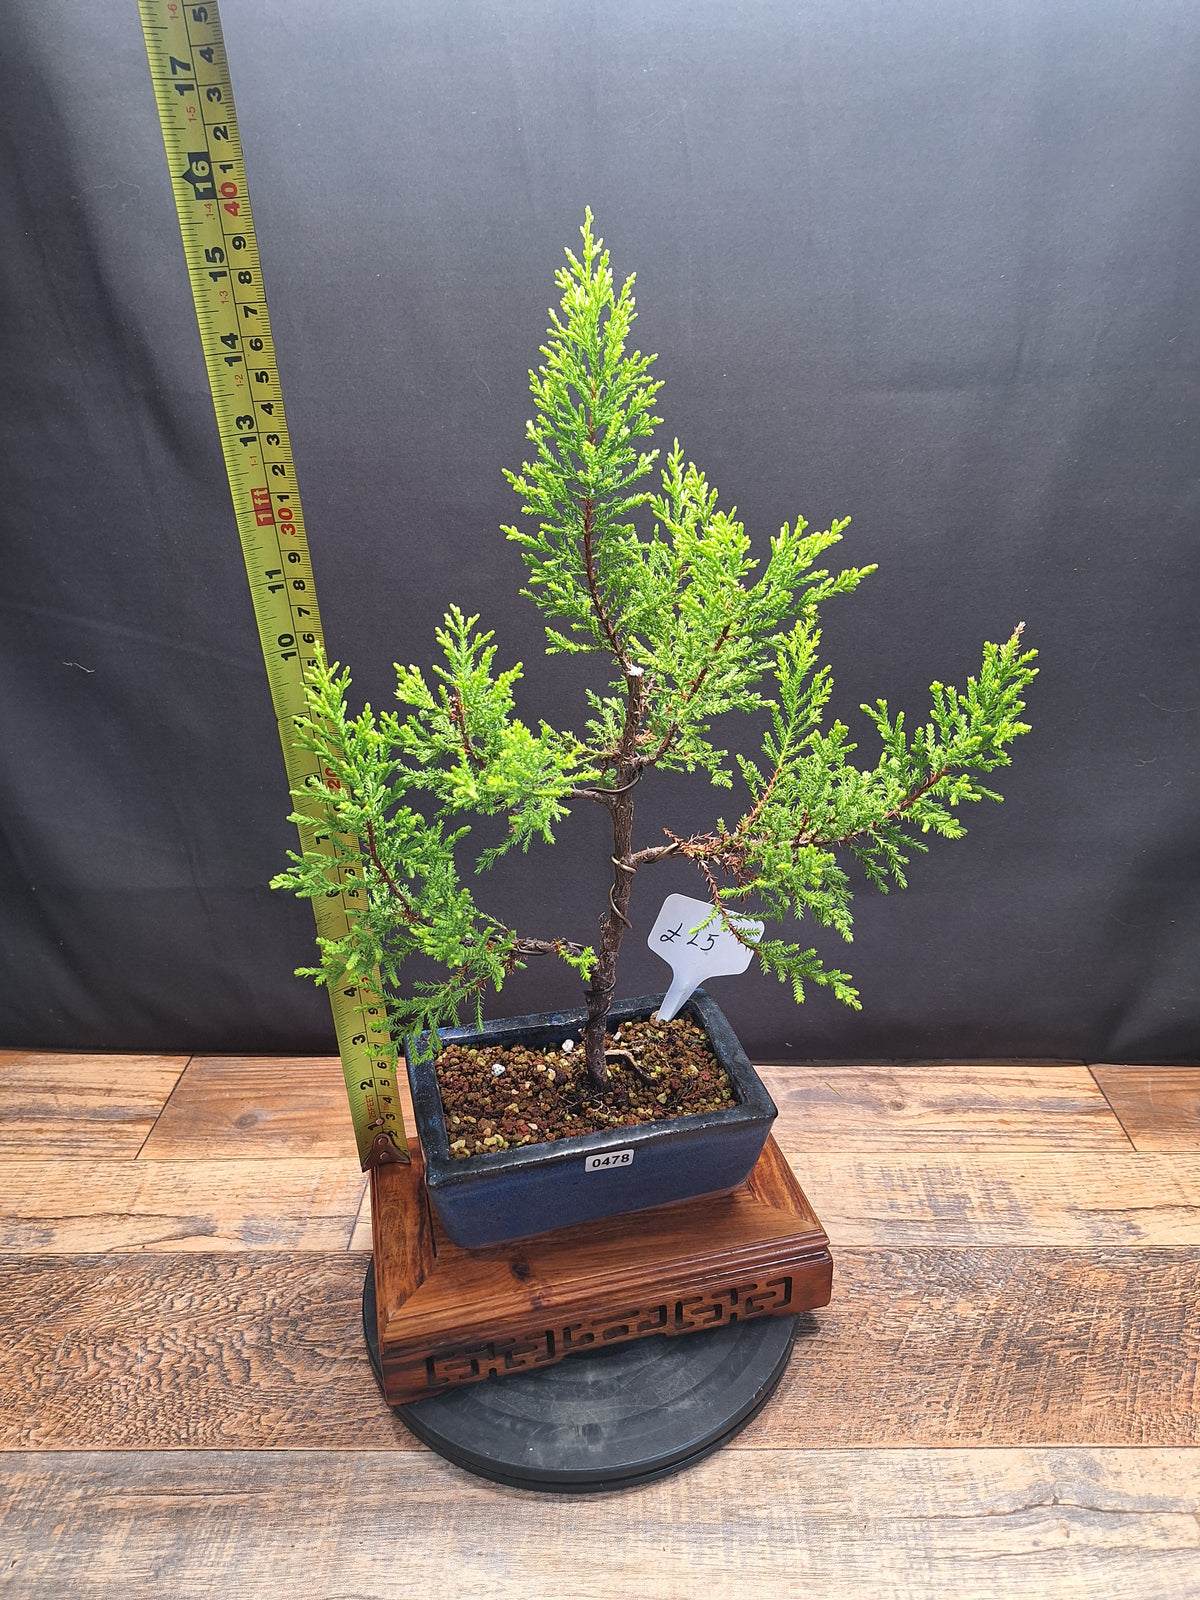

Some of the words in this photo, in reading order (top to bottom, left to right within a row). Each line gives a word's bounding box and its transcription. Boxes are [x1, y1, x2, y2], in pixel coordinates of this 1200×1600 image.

[167, 3, 180, 20] 1-6
[192, 6, 208, 23] 5
[200, 47, 215, 63] 4
[169, 56, 195, 96] 17
[206, 87, 222, 103] 3
[186, 106, 198, 122] 1-5
[213, 125, 229, 141] 2
[219, 163, 234, 174] 1
[191, 160, 213, 193] 16
[220, 181, 240, 217] 40
[204, 203, 213, 218] 1-4
[232, 235, 246, 250] 9
[205, 246, 228, 282] 15
[238, 271, 252, 285] 8
[219, 290, 229, 305] 1-3
[243, 305, 258, 319] 7
[220, 332, 243, 367] 14
[249, 337, 264, 351] 6
[234, 374, 244, 388] 1-2
[255, 371, 270, 384] 5
[260, 402, 274, 415] 4
[235, 414, 257, 447] 13
[266, 433, 280, 446] 3
[250, 455, 258, 468] 1-1
[272, 464, 286, 477] 2
[277, 494, 290, 503] 1
[277, 507, 296, 536] 30
[287, 551, 301, 564] 9
[264, 568, 285, 594] 11
[293, 579, 306, 591] 8
[297, 606, 311, 617] 7
[302, 633, 315, 644] 6
[277, 633, 297, 661] 10
[344, 987, 357, 997] 4
[352, 1034, 365, 1046] 3
[377, 1061, 387, 1069] 6
[360, 1079, 374, 1091] 2
[380, 1079, 390, 1087] 5
[383, 1096, 392, 1104] 4
[385, 1113, 395, 1121] 3
[592, 1153, 630, 1167] 0478
